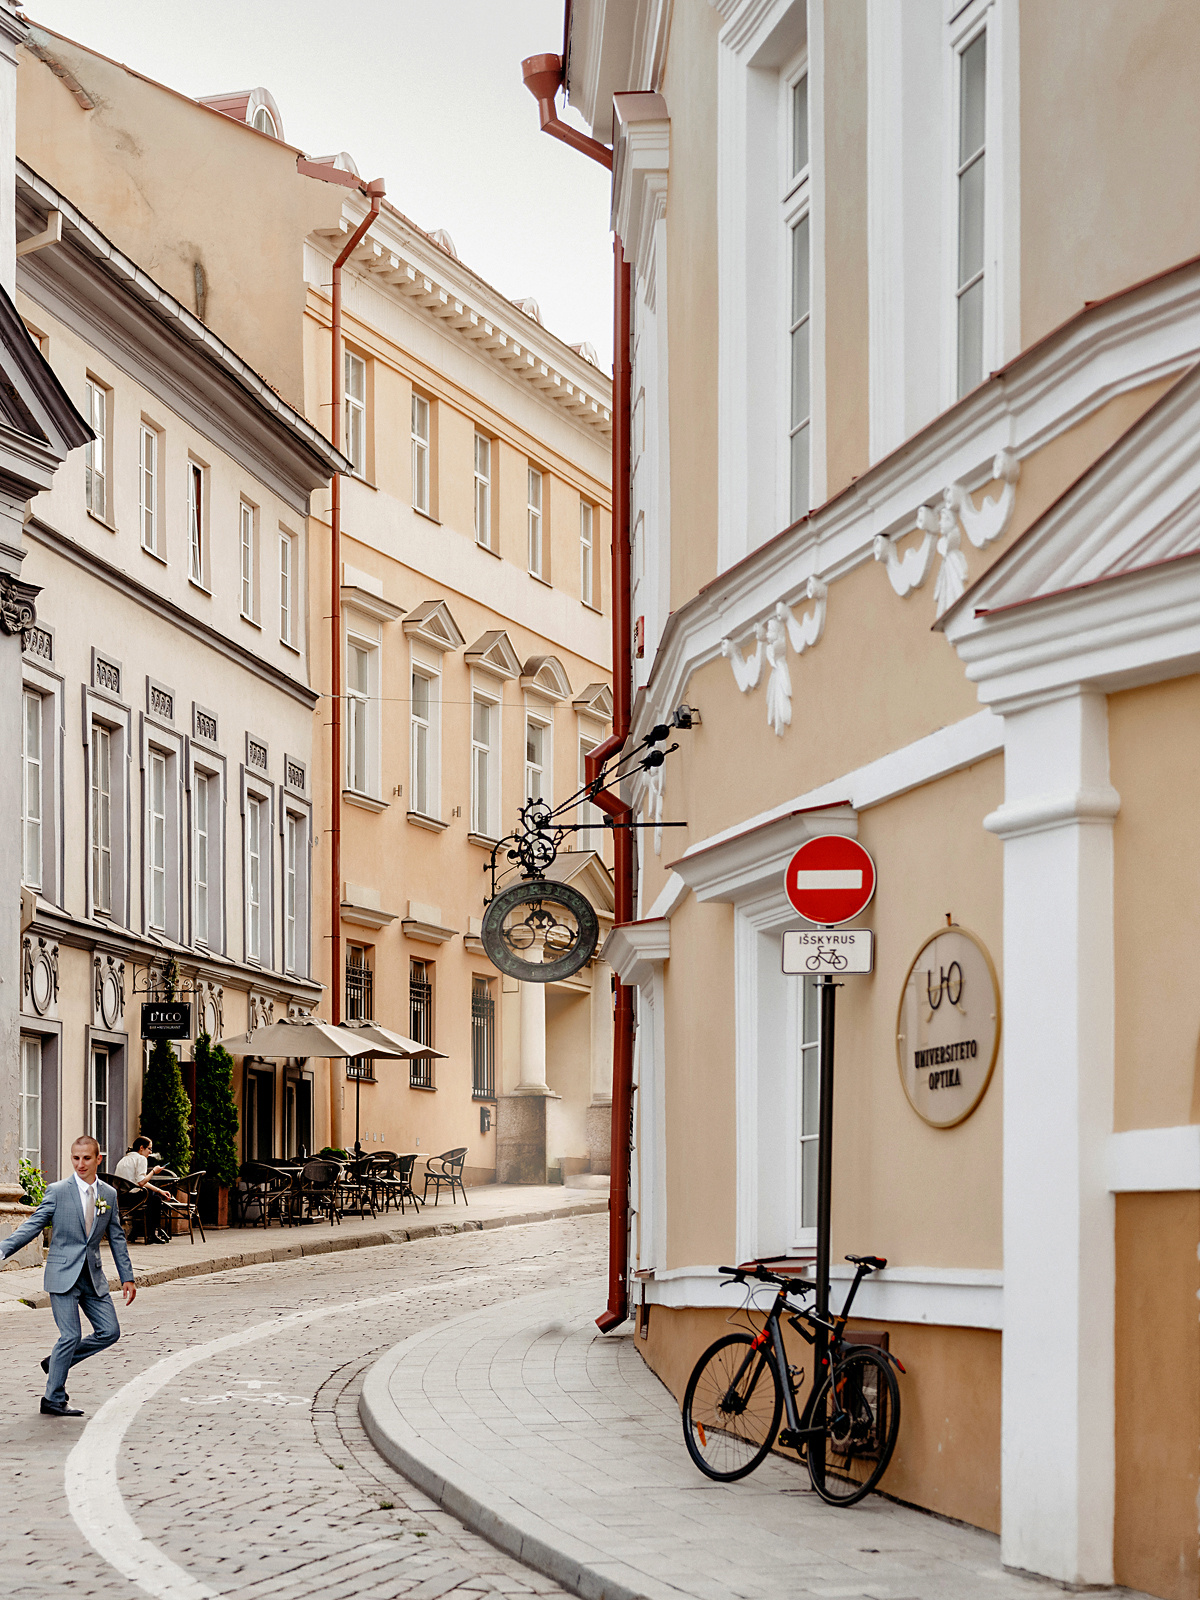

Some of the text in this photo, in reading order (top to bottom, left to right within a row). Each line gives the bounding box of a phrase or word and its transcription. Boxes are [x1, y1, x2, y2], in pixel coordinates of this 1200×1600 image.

[799, 933, 856, 945] IŠSKYRUS
[914, 1039, 977, 1069] UNIVERSITETO
[928, 1068, 961, 1090] OPTIKA
